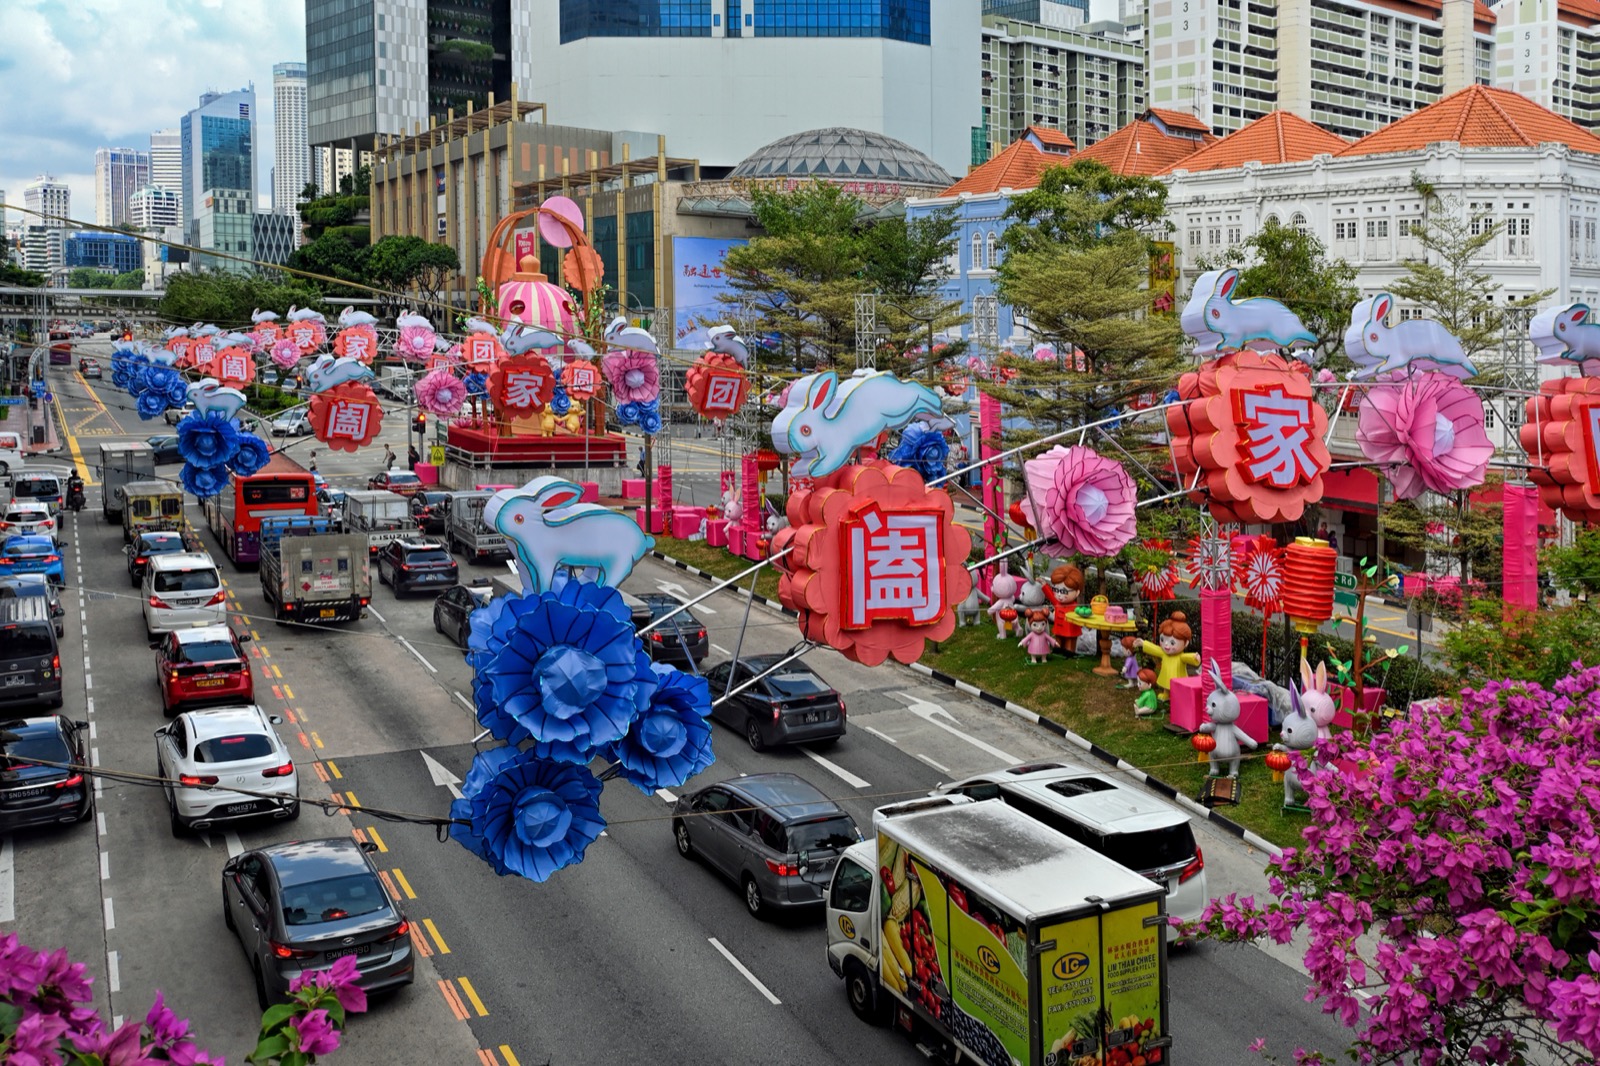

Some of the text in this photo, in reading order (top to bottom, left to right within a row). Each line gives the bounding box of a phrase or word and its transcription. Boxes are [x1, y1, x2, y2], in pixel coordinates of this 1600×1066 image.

[260, 328, 276, 344] 家
[294, 328, 316, 348] 家
[346, 335, 368, 358] 家
[472, 340, 495, 362] 团
[222, 354, 247, 381] 阖
[507, 371, 544, 408] 家
[706, 376, 740, 410] 团
[326, 401, 370, 440] 阖
[1243, 386, 1320, 486] 家
[851, 511, 940, 624] 阖
[1342, 576, 1352, 586] Rd
[1108, 954, 1155, 972] LIM THIAM CHWEE
[1108, 971, 1119, 979] FOOD
[1120, 966, 1138, 976] SUPPLIER
